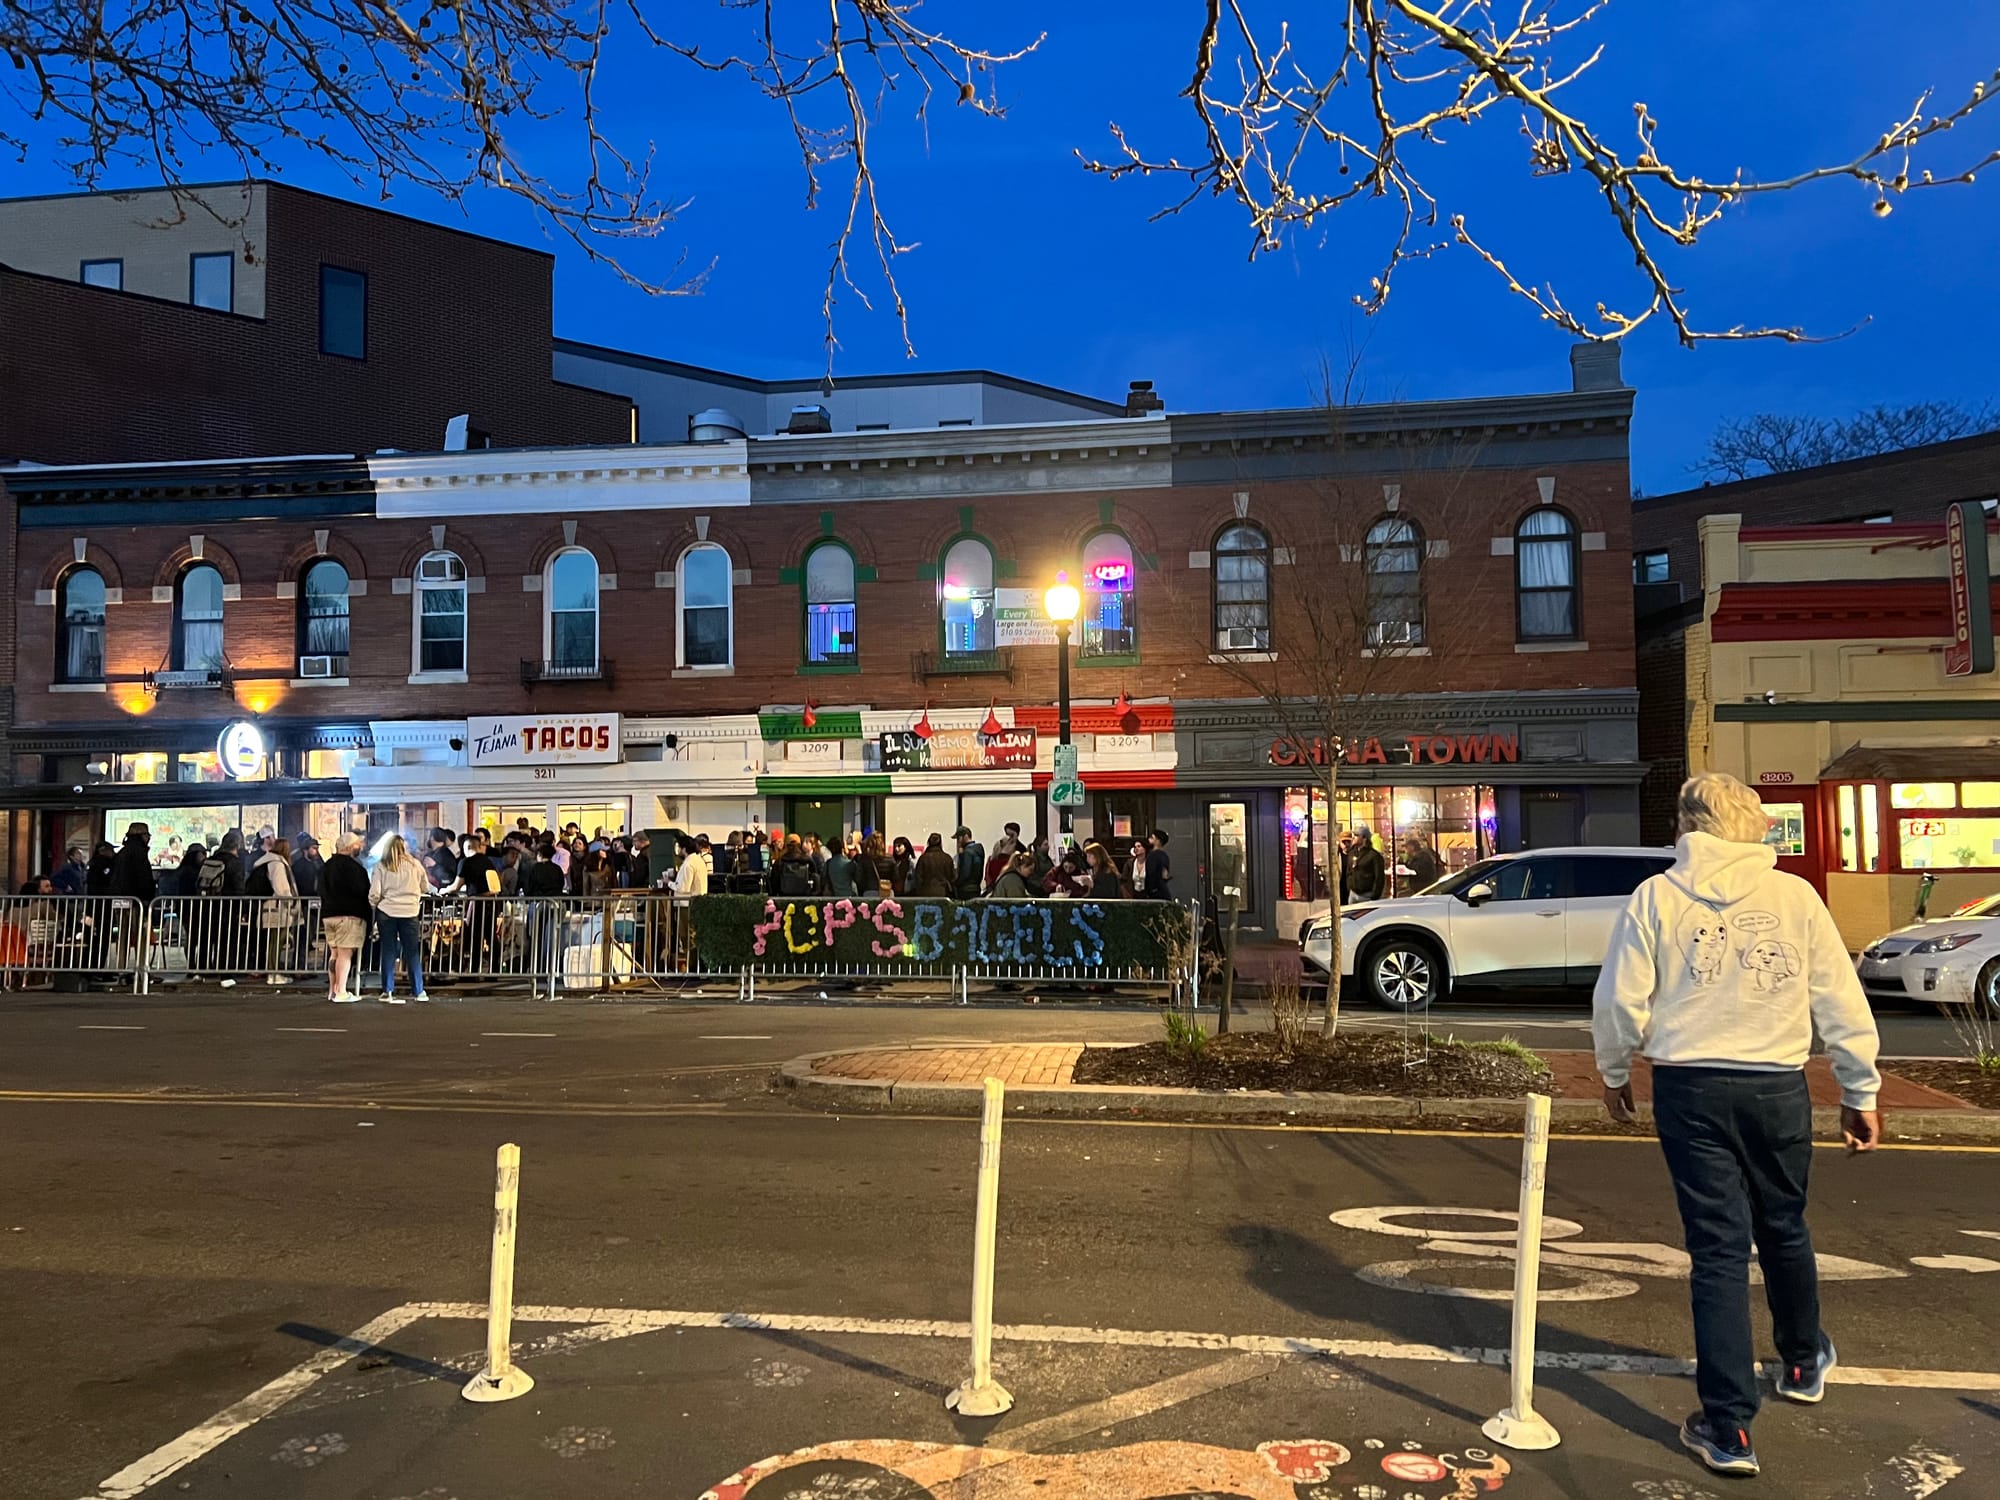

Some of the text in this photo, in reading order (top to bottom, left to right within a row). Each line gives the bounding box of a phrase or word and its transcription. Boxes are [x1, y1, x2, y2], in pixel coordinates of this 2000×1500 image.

[1951, 510, 1968, 642] ANGELICO
[1003, 609, 1028, 620] Every
[997, 620, 1015, 628] Large
[493, 724, 503, 735] LA
[474, 733, 517, 759] TEJANA
[521, 725, 610, 754] TACOS
[884, 732, 1032, 753] IL SUPREMO ITALIAN
[1109, 736, 1140, 747] 3209
[801, 743, 829, 753] 3209
[1405, 734, 1517, 764] TOWN
[979, 750, 996, 766] Bar
[534, 768, 557, 779] 3211
[1762, 773, 1792, 783] 3205
[914, 904, 1105, 967] BAGELS
